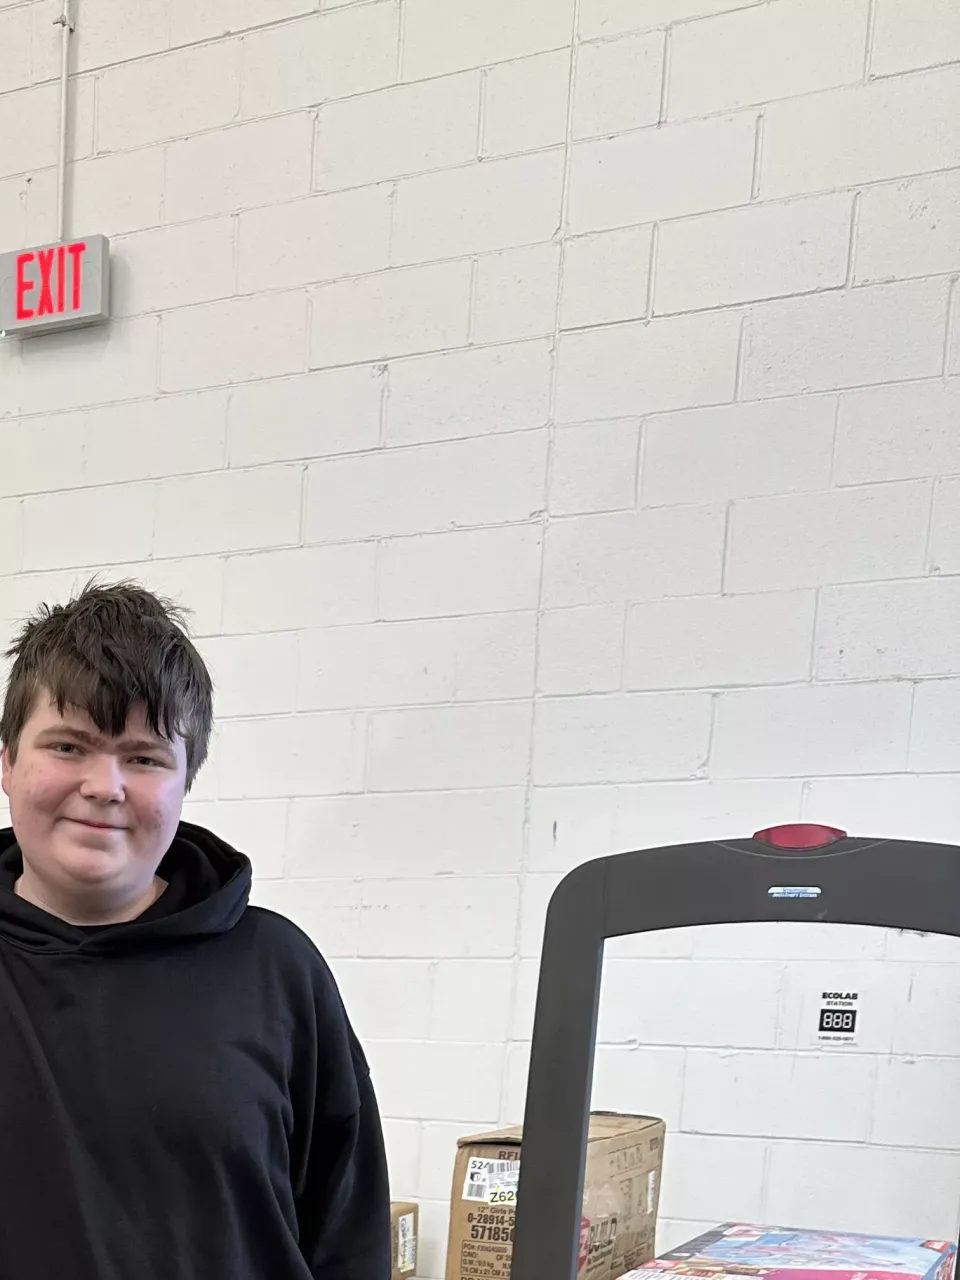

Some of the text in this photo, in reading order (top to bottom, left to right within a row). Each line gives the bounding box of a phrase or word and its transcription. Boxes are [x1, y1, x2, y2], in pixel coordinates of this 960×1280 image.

[16, 242, 86, 320] EXIT
[822, 992, 858, 1000] ECOLAB
[823, 1012, 852, 1029] 888
[498, 1150, 519, 1161] RFI
[489, 1190, 517, 1203] Z62
[467, 1212, 516, 1227] 0-28914-5
